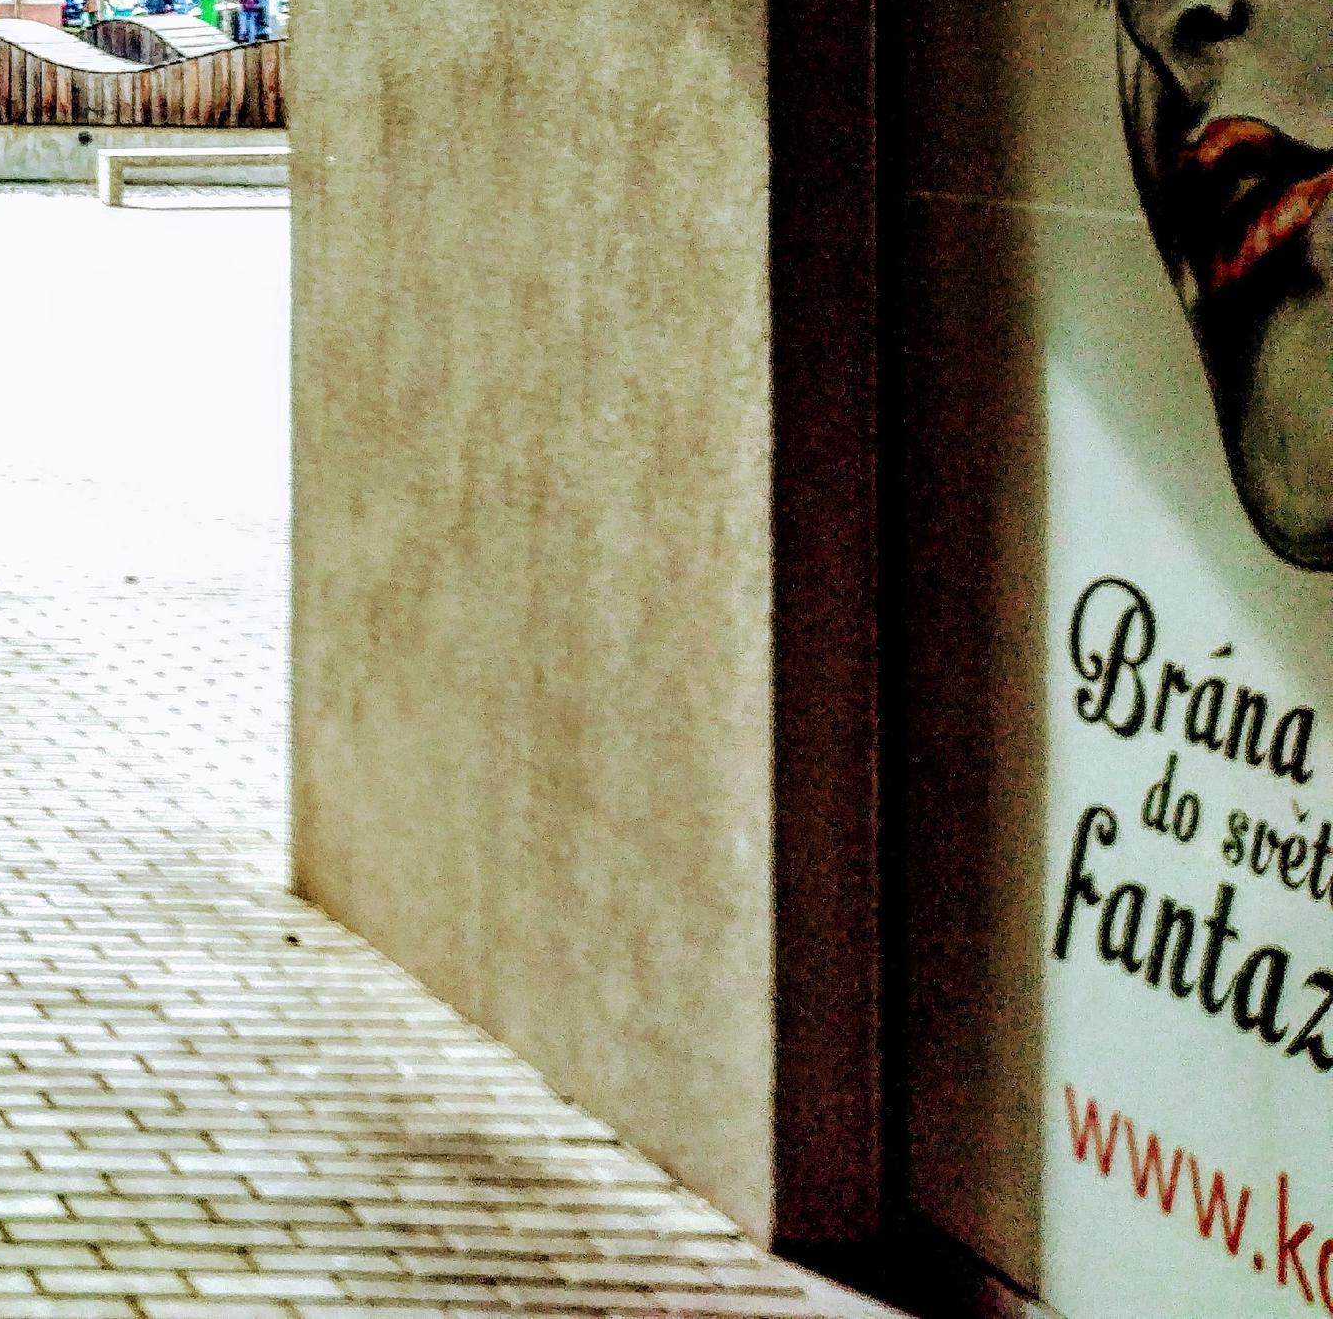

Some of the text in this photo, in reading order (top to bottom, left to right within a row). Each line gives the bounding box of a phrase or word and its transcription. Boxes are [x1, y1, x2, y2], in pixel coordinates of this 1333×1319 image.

[1069, 575, 1315, 785] Brána
[1141, 750, 1333, 909] do svět
